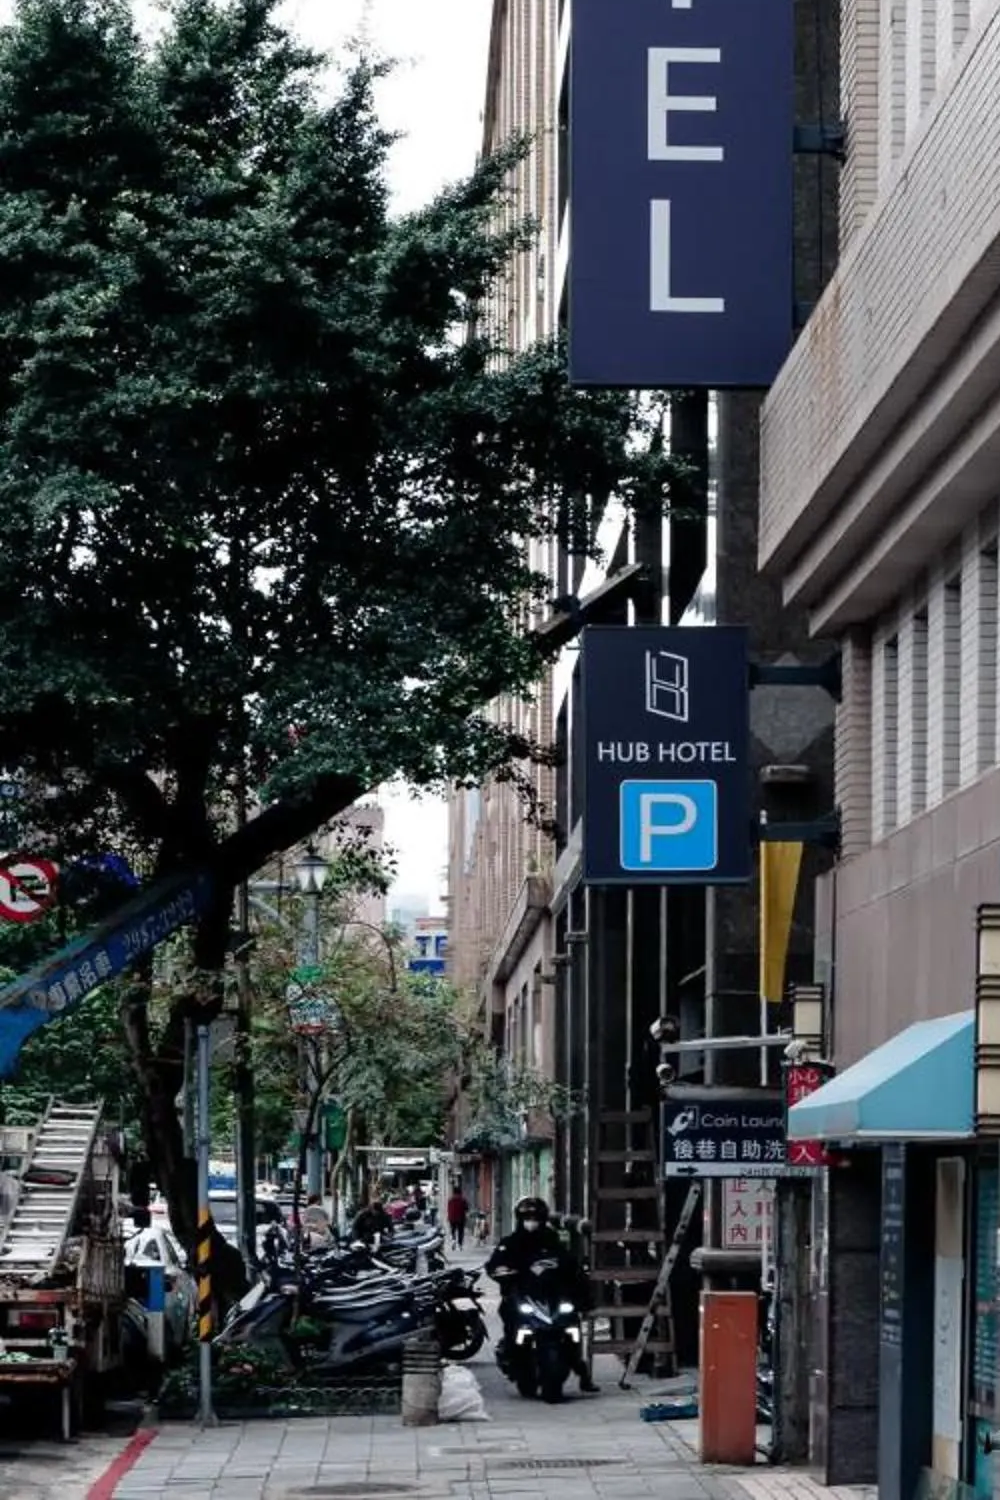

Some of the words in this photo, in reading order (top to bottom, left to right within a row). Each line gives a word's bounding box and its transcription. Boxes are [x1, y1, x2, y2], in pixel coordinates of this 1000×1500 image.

[598, 741, 651, 763] HUB
[658, 741, 736, 763] HOTEL
[639, 793, 698, 863] P
[701, 1114, 739, 1128] Coin
